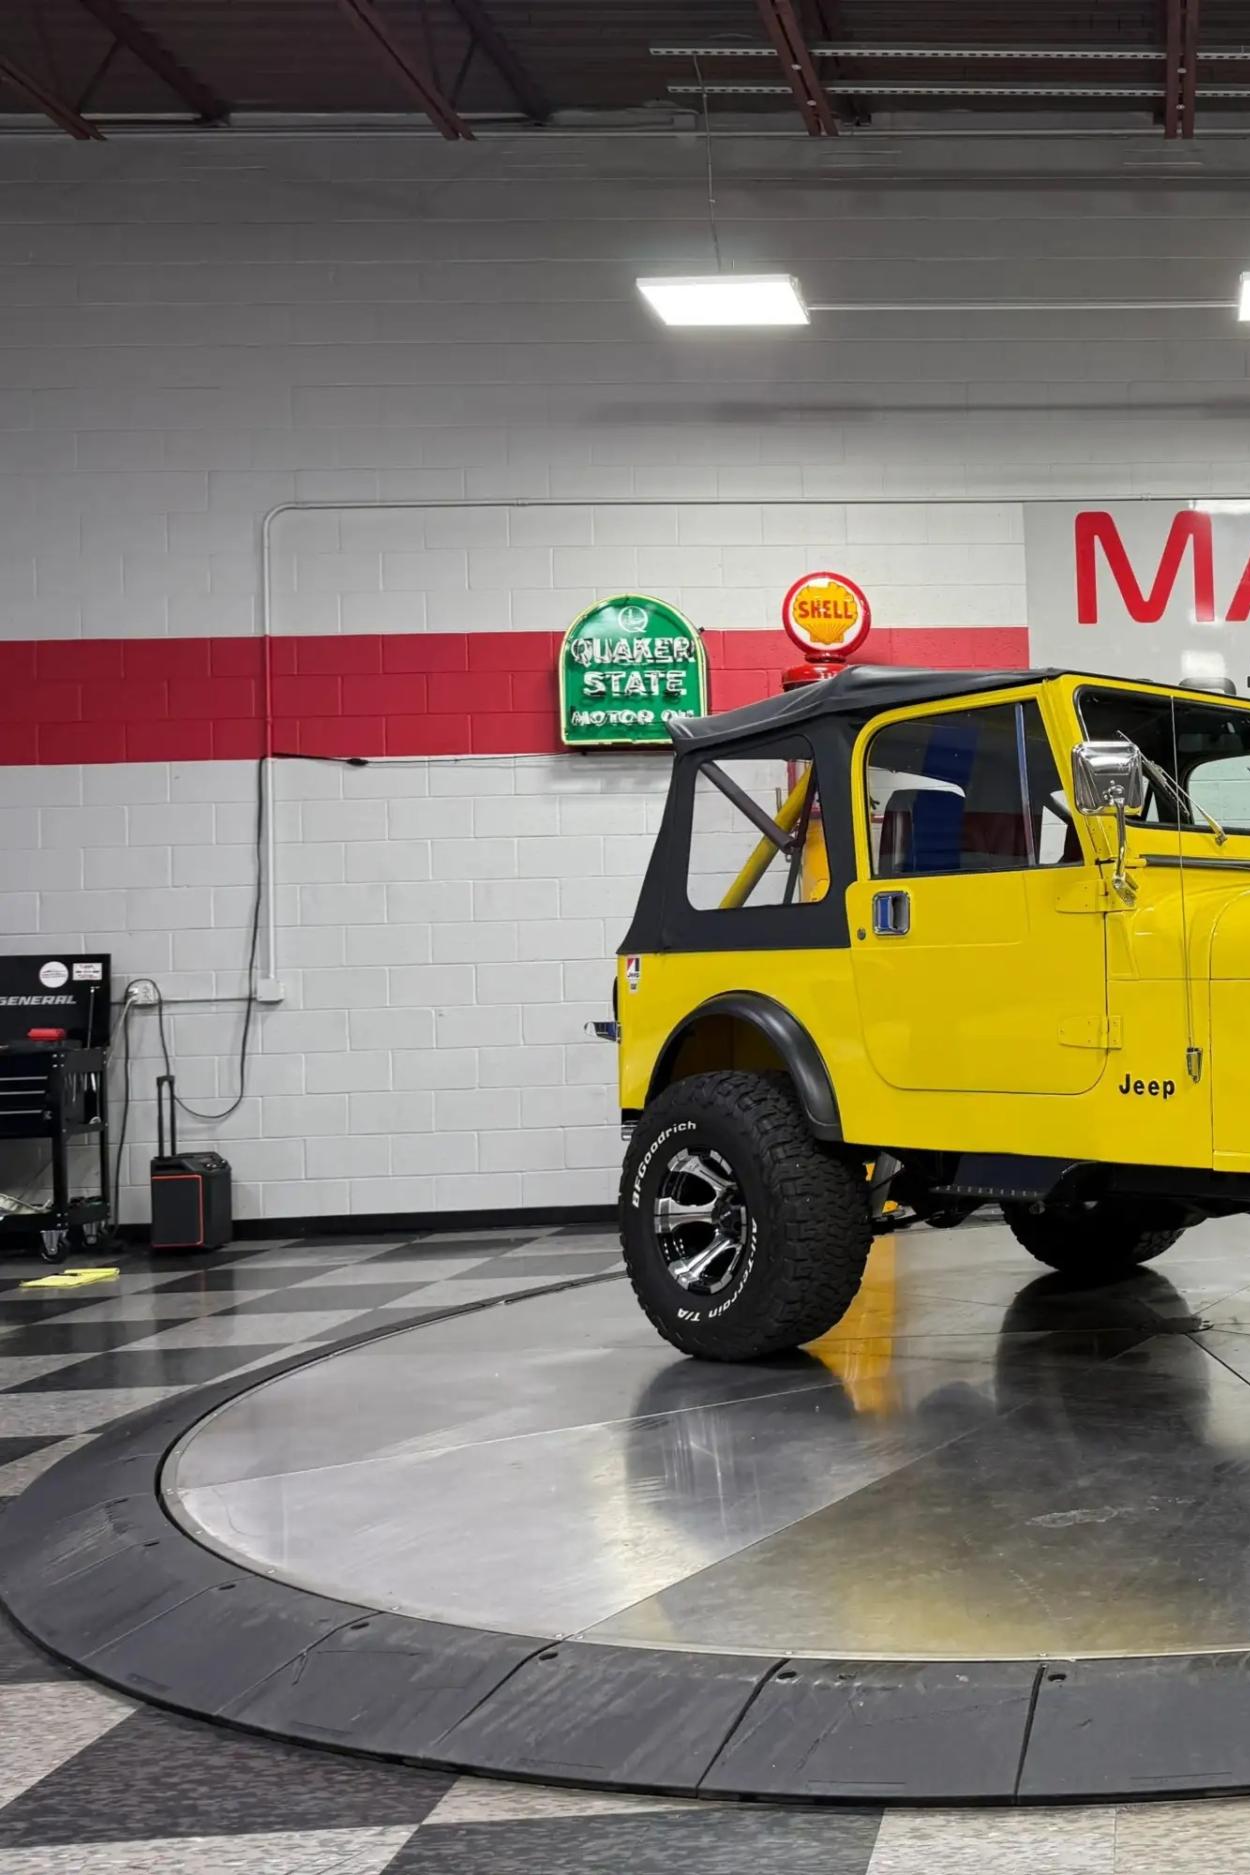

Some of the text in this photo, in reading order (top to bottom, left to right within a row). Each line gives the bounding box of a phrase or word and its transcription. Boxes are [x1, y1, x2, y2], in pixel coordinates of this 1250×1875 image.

[798, 600, 853, 619] SHELL
[571, 637, 695, 667] QUAKER
[583, 670, 687, 696] STATE
[572, 709, 654, 726] MOTOR
[1119, 1073, 1175, 1100] Jeep
[632, 1120, 697, 1208] BFGoodrich
